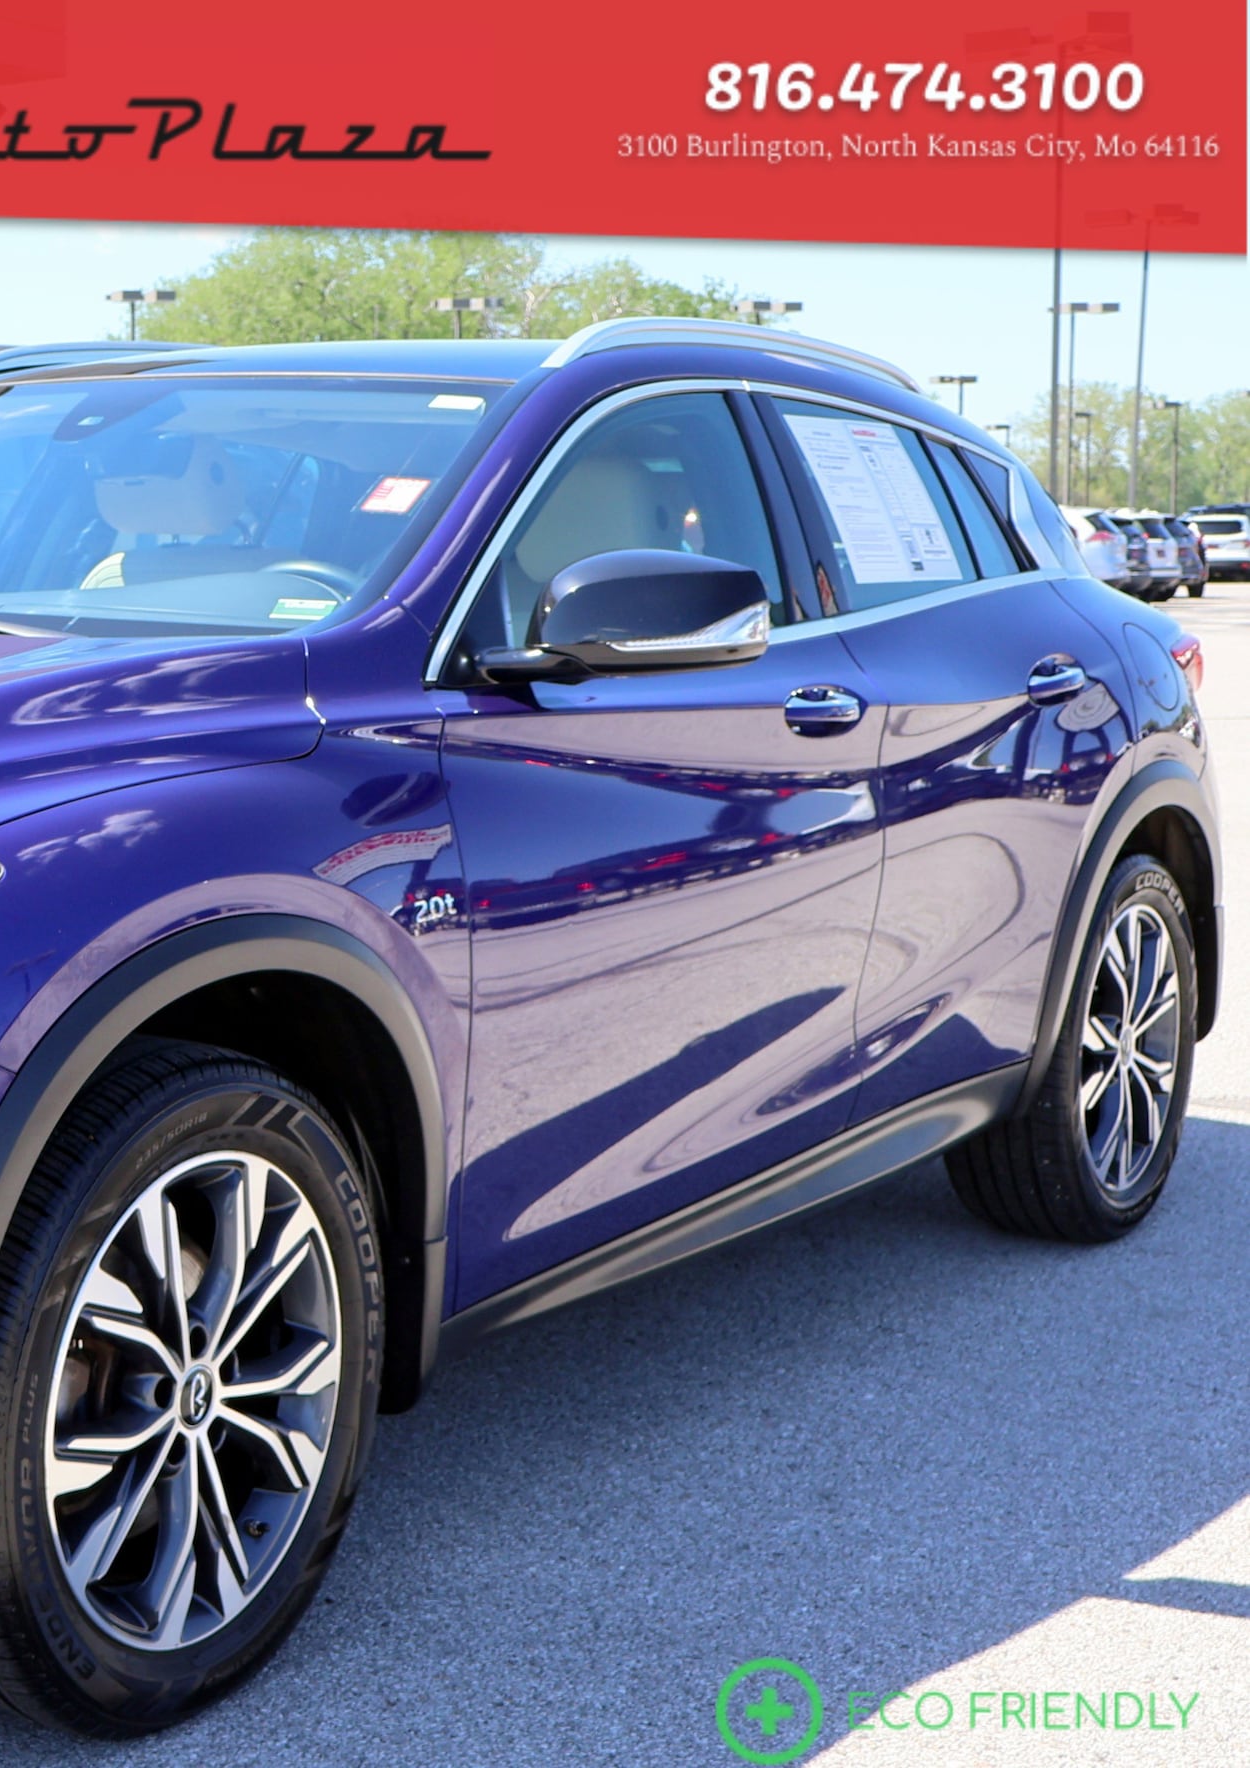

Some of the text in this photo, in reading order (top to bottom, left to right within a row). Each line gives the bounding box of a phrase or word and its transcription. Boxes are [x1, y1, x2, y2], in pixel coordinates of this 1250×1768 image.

[1134, 871, 1185, 915] COOPER
[335, 1170, 381, 1384] COOPER
[20, 1372, 97, 1681] ENDEVOR PLUS
